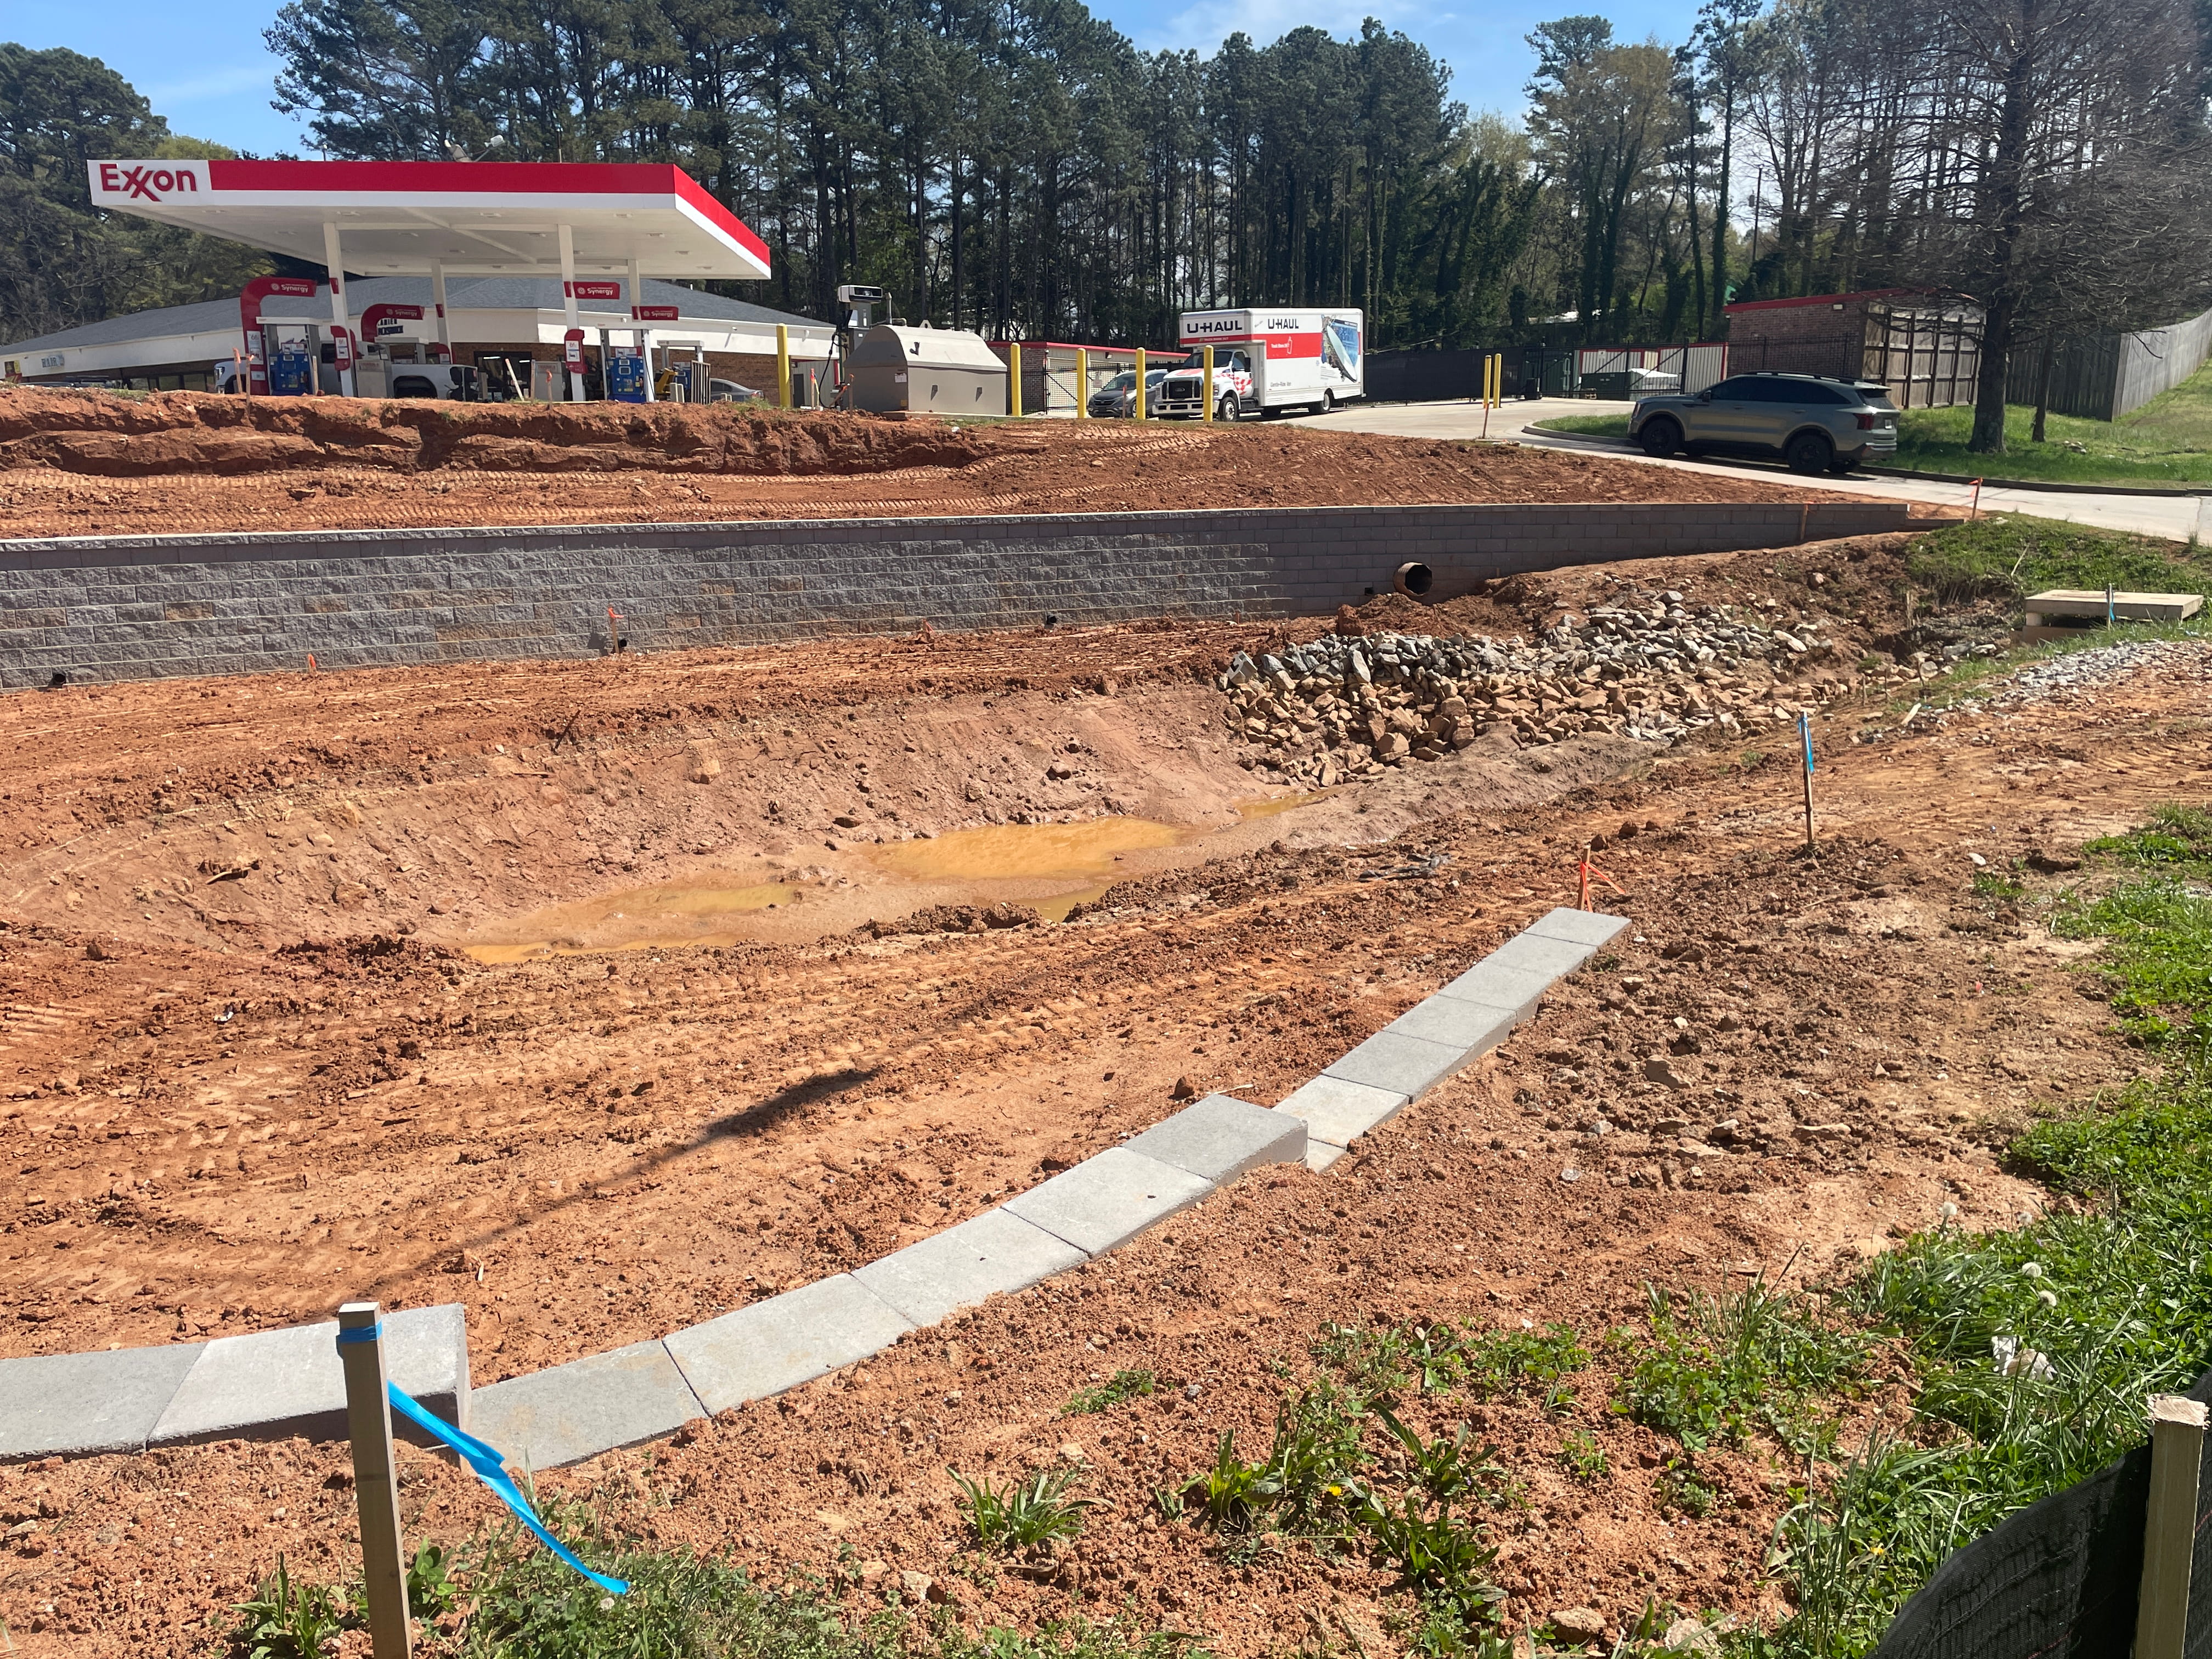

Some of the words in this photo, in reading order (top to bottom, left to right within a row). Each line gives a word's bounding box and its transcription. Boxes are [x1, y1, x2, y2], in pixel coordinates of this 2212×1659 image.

[99, 163, 198, 202] Exxon
[281, 284, 308, 293] Synergy
[1187, 320, 1243, 334] U-HAUL
[1268, 318, 1299, 329] U-HAUL
[41, 357, 58, 368] HAIR
